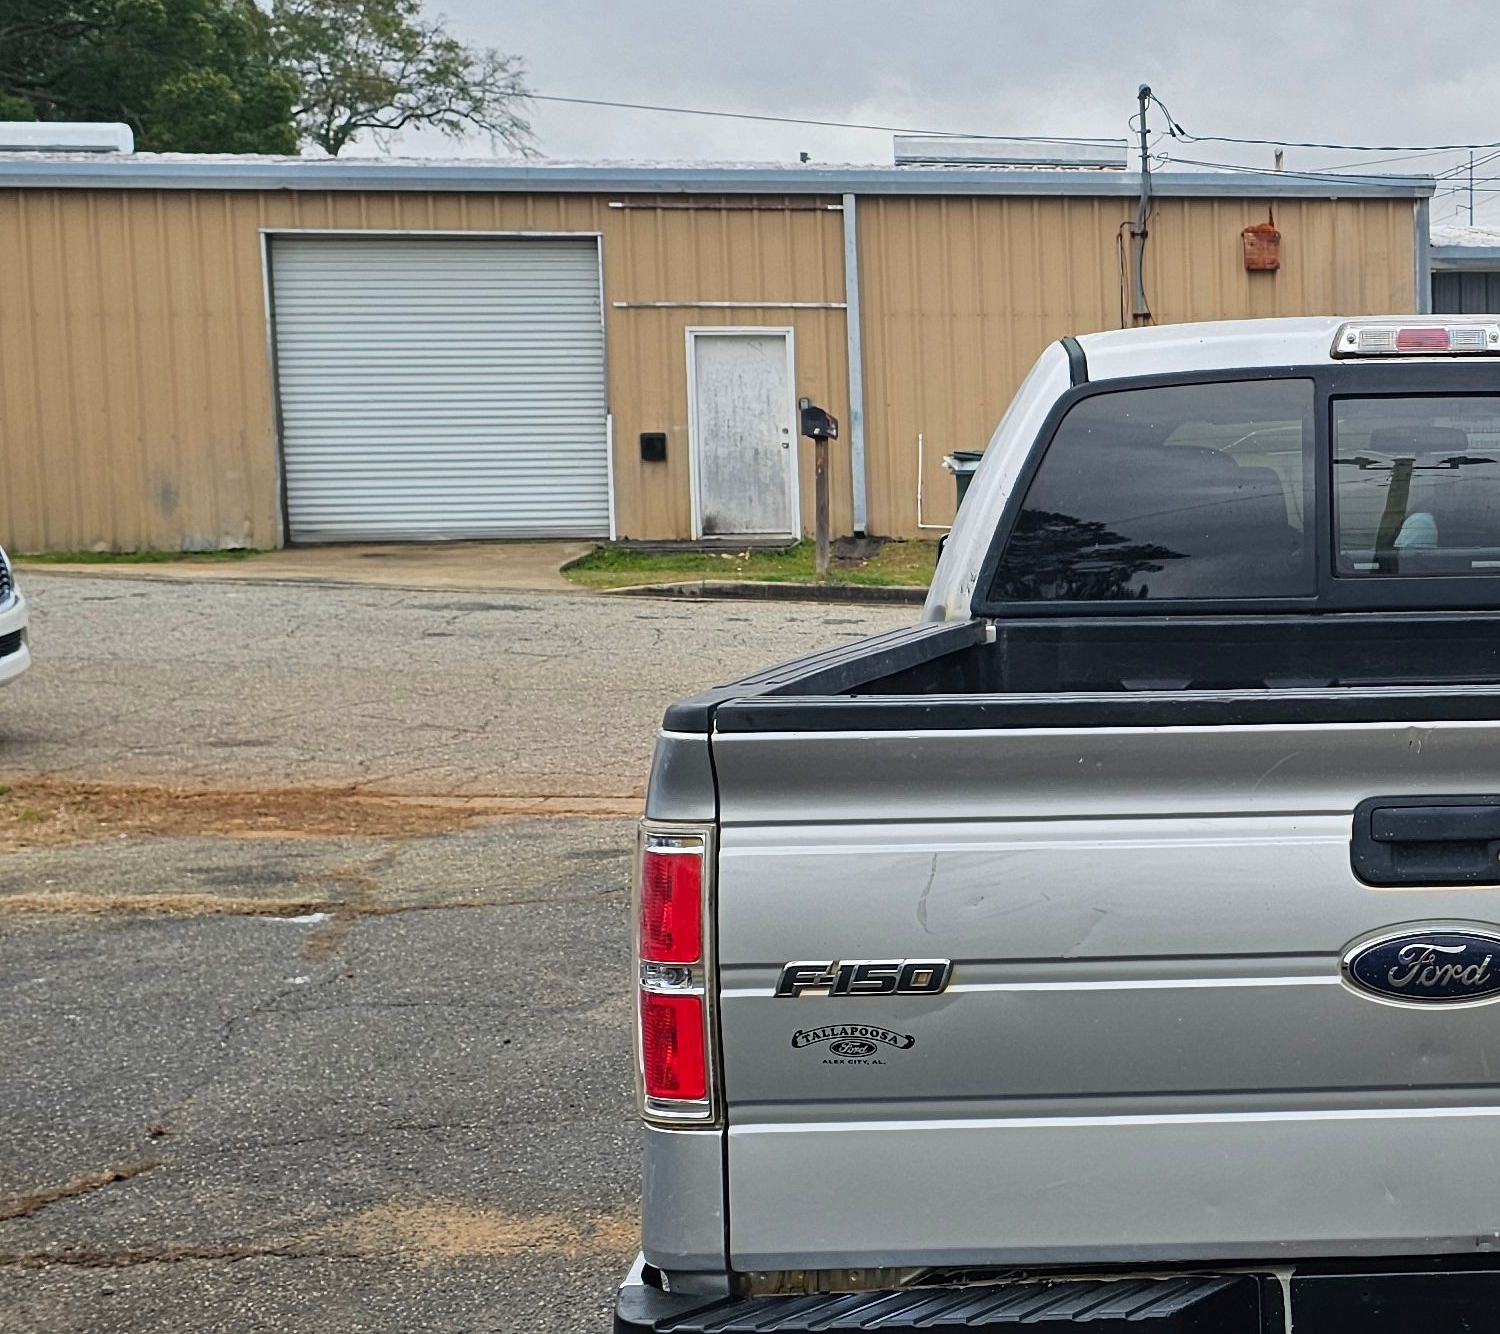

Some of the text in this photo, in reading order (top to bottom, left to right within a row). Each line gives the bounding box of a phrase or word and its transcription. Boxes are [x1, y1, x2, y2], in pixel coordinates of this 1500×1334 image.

[1387, 943, 1493, 988] Ford
[801, 1027, 899, 1045] TALLAPOOSA
[838, 1041, 869, 1054] Ford
